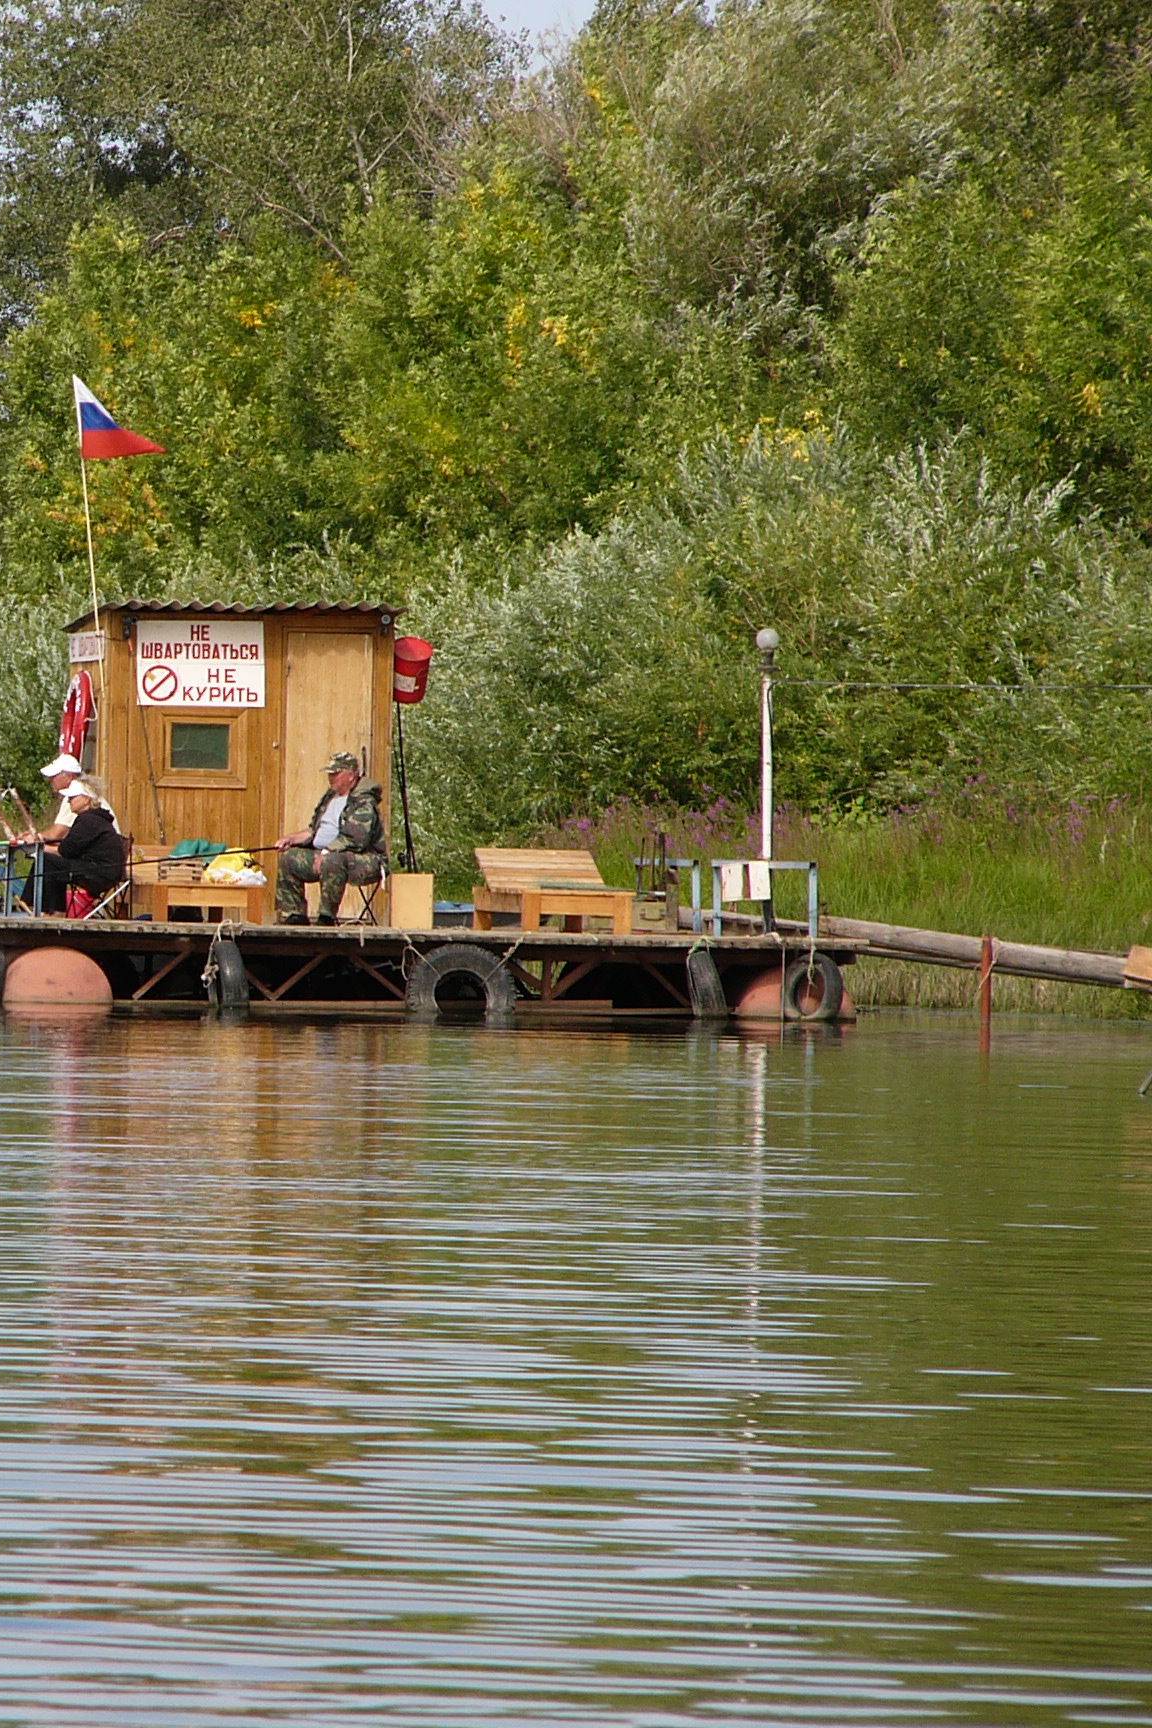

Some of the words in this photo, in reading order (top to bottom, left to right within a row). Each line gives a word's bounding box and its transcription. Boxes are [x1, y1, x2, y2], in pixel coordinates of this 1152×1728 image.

[191, 625, 210, 641] НЕ
[142, 643, 258, 660] ШВАРТОВАТЬСЯ
[208, 669, 236, 683] НЕ
[183, 686, 258, 702] КУРИТЬ
